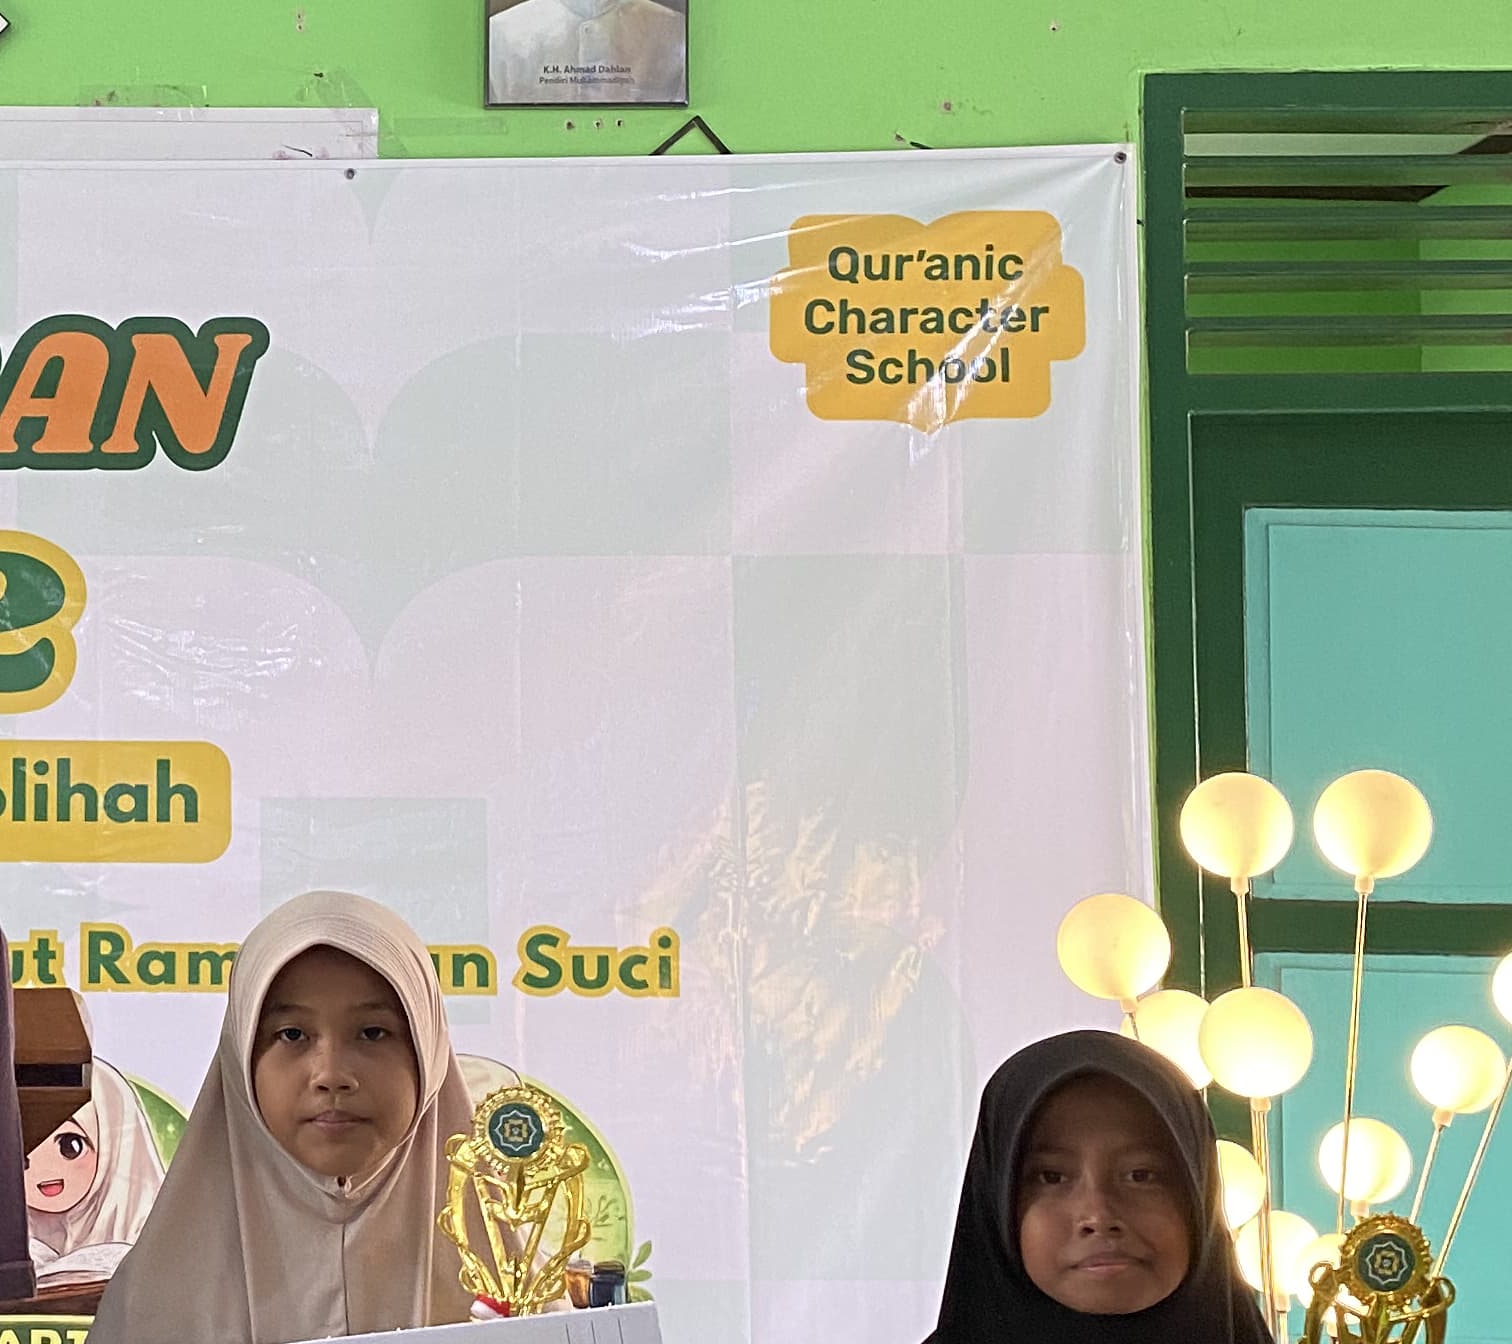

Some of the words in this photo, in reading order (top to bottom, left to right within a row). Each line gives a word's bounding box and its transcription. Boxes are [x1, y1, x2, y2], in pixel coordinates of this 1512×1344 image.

[543, 65, 562, 74] K.H.
[564, 65, 596, 74] Ahmad
[804, 298, 1049, 335] Character
[845, 348, 1010, 385] School
[524, 932, 673, 990] Suci
